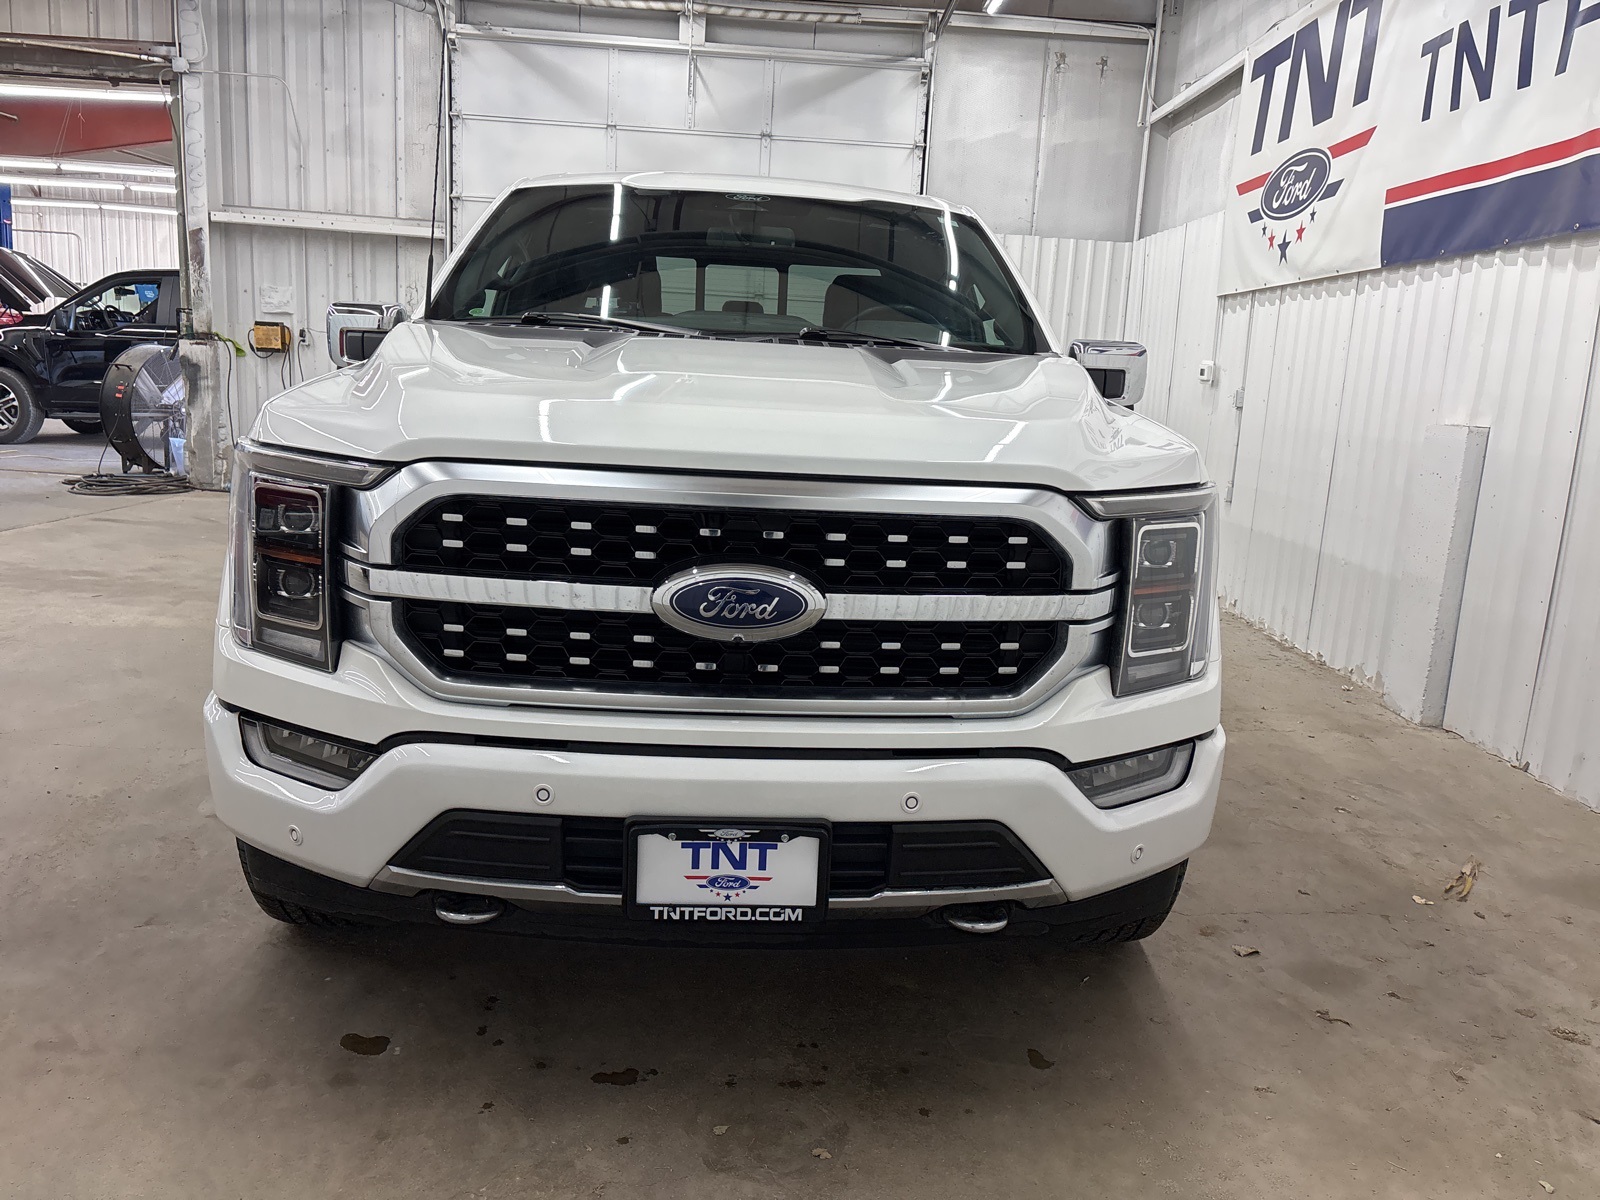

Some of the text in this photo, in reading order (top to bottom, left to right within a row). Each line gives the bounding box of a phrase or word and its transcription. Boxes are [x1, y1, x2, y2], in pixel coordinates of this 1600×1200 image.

[1250, 0, 1384, 156] TNT
[1272, 162, 1317, 209] Ford
[700, 586, 780, 620] Ford
[681, 841, 778, 871] TNT
[714, 876, 742, 888] Ford
[649, 906, 803, 922] TNTFORD.COM
